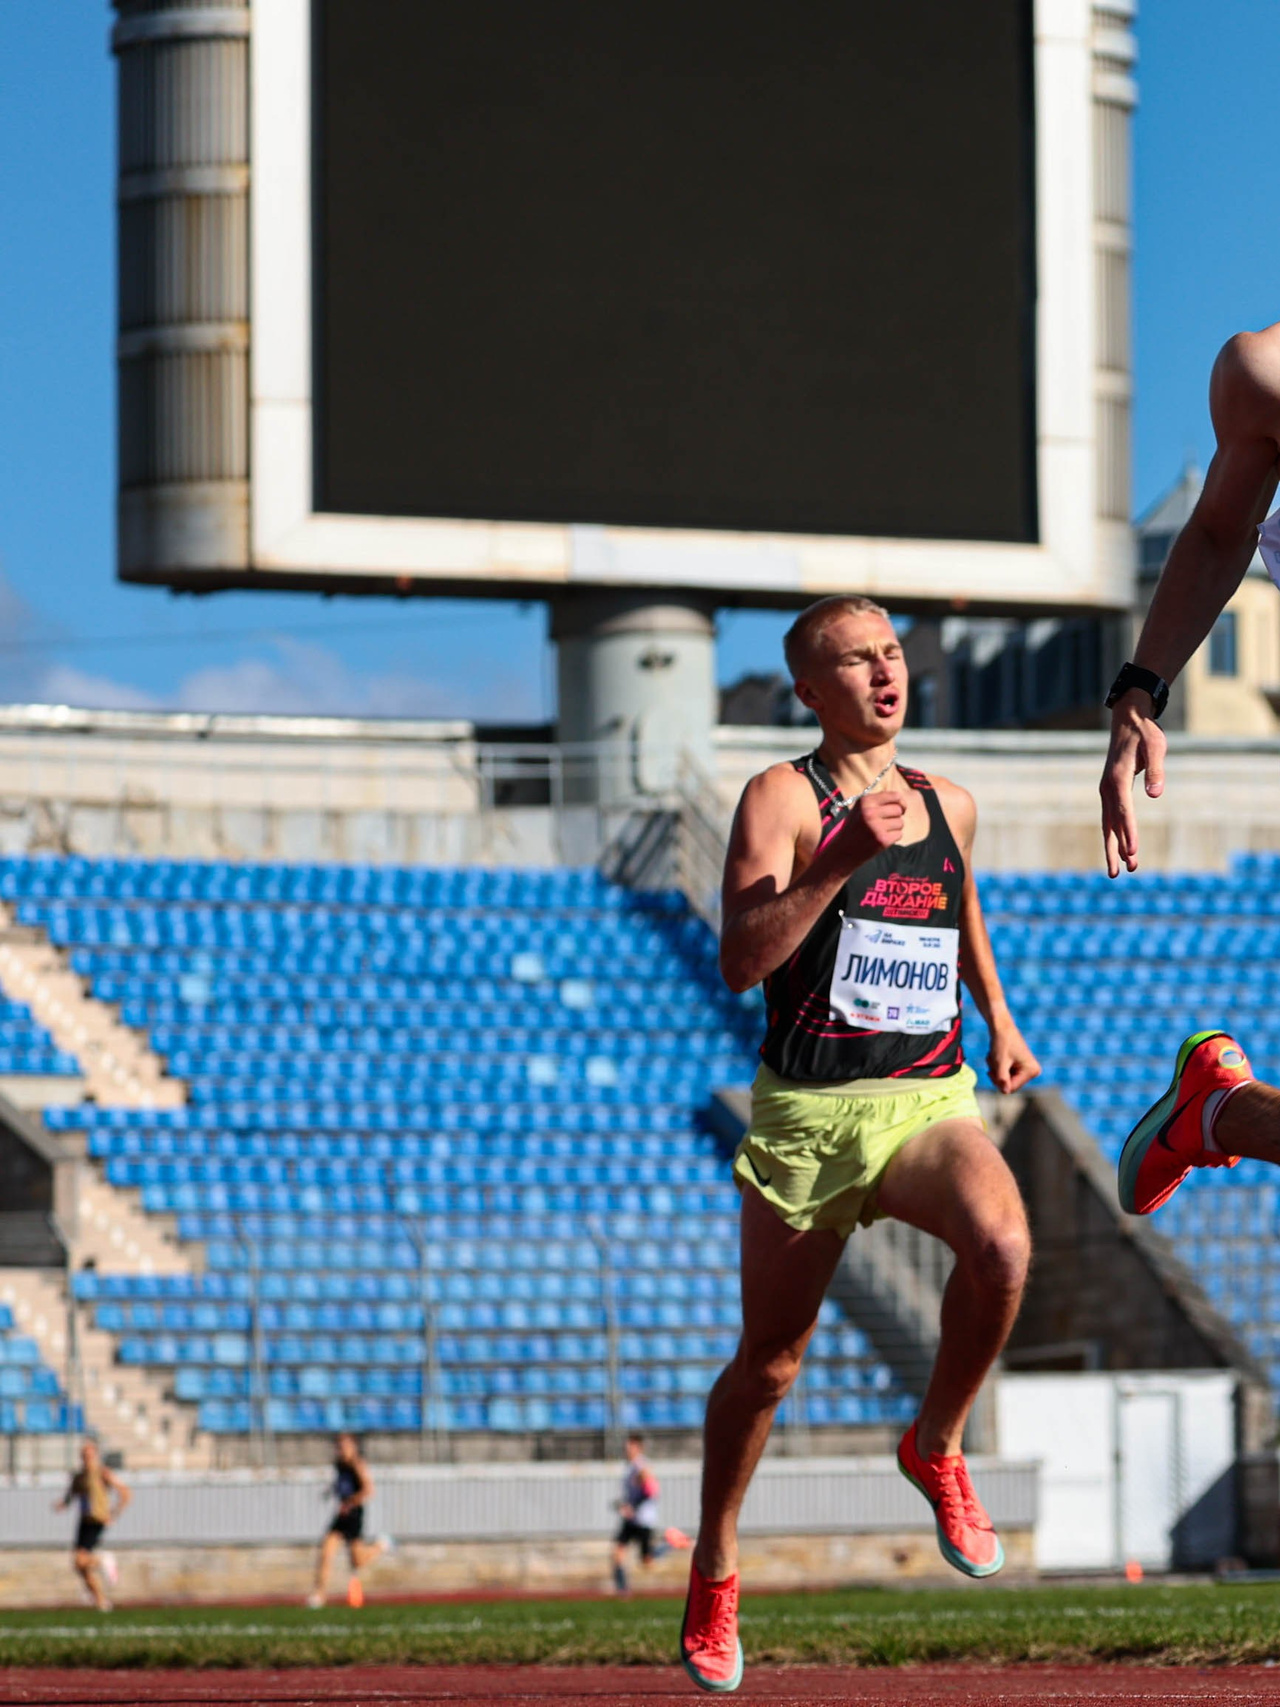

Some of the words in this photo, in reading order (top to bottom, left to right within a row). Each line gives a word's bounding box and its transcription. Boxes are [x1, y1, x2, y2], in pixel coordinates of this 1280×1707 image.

[874, 878, 943, 896] ВТОРОЕ
[860, 891, 948, 910] ДЫХАНИЕ
[841, 954, 949, 990] ЛИМОНОВ
